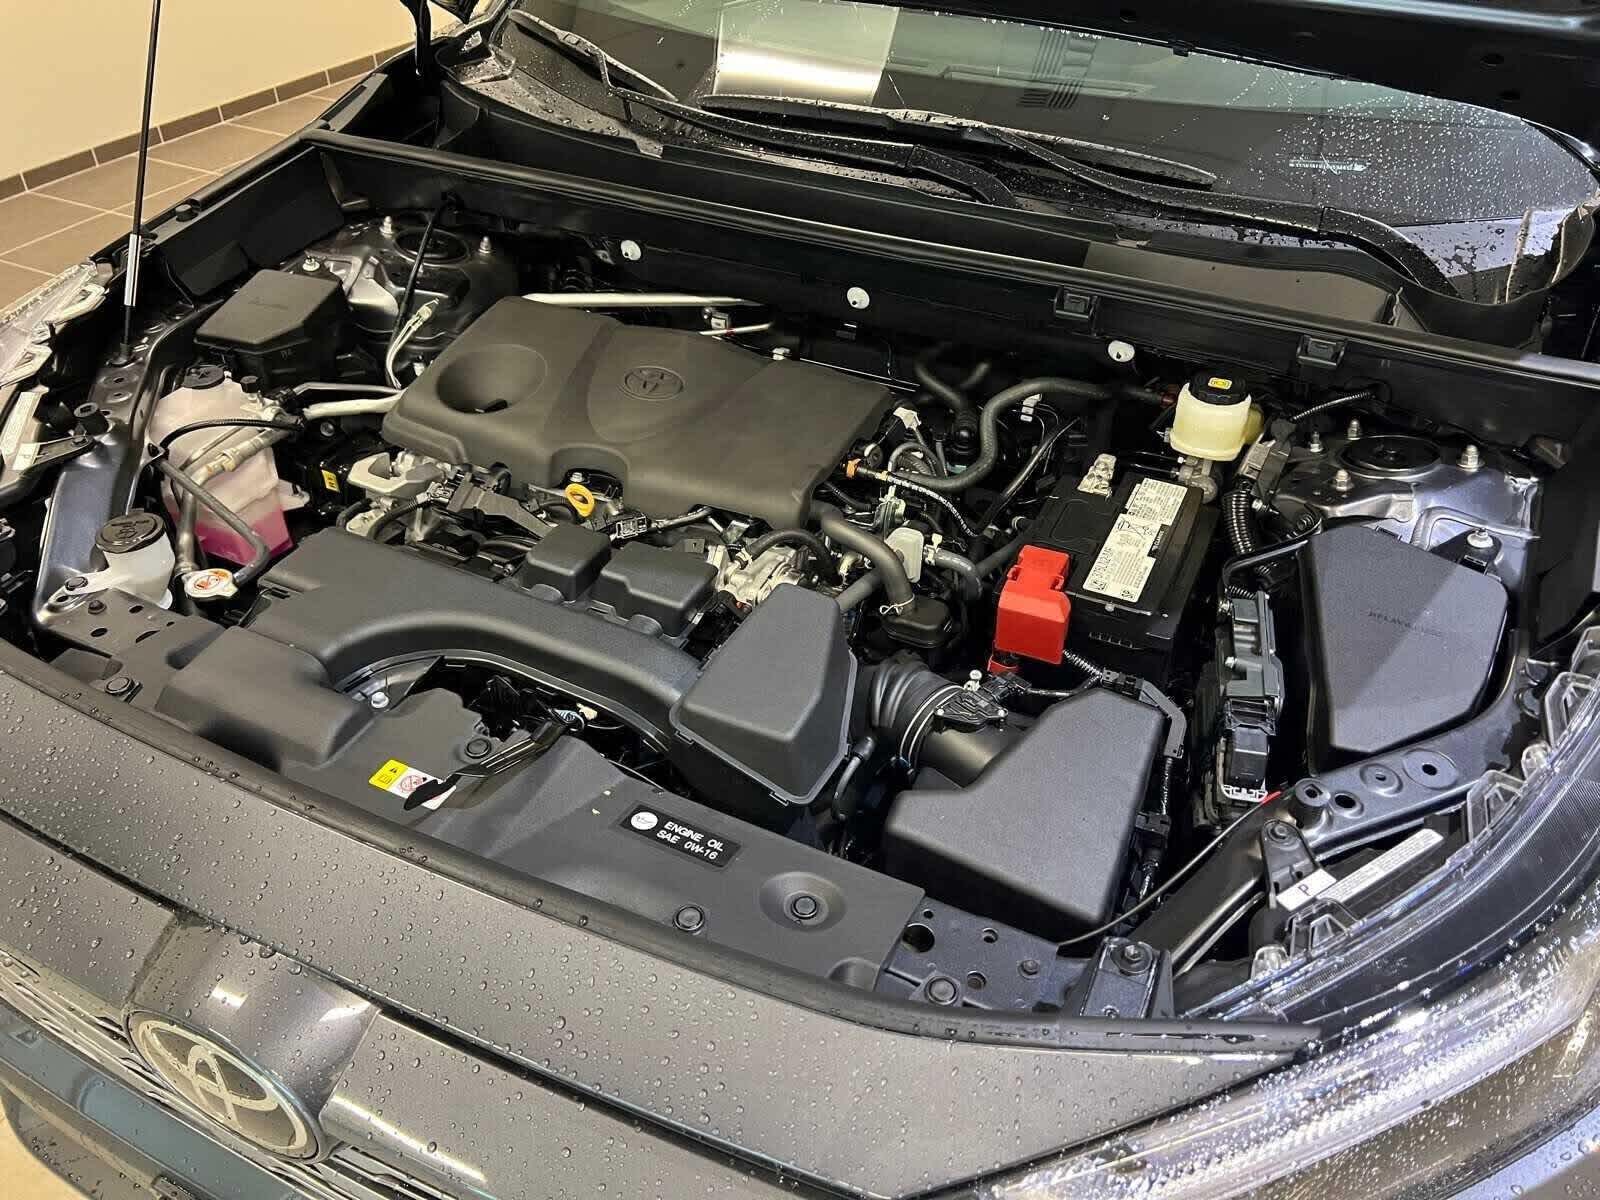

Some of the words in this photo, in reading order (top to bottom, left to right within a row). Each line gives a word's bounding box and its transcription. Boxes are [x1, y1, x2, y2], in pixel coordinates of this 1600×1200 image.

[656, 829, 681, 844] SAE
[684, 841, 719, 860] 0W-16
[664, 821, 704, 842] ENGINE
[707, 839, 725, 852] OIL
[1297, 883, 1311, 897] P
